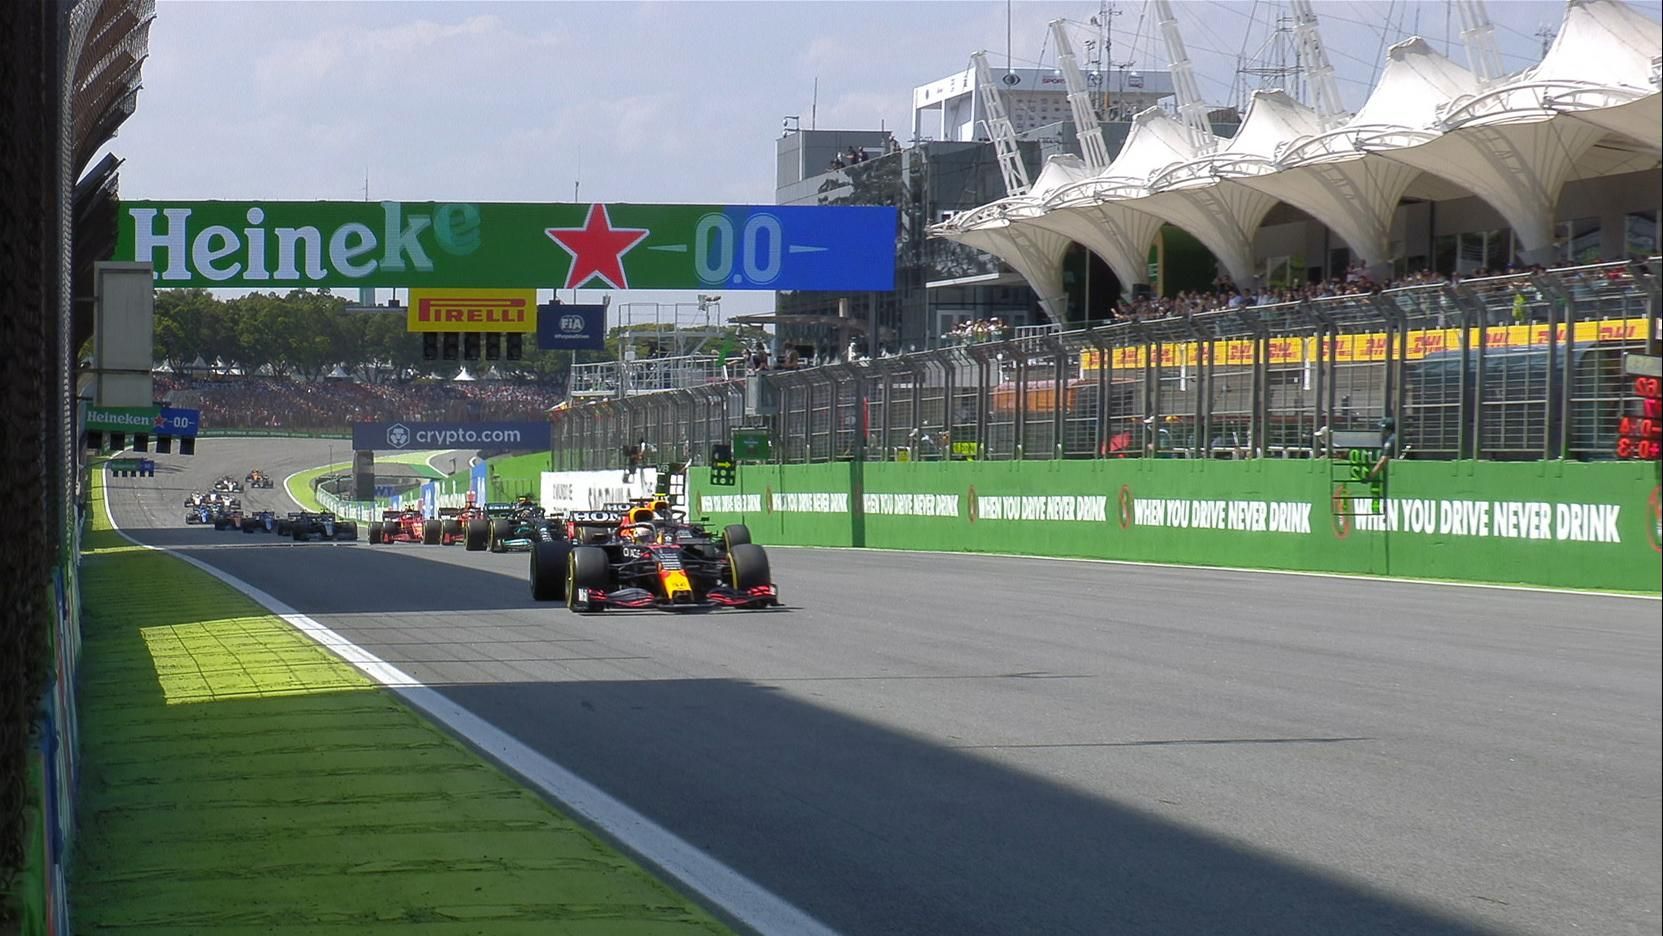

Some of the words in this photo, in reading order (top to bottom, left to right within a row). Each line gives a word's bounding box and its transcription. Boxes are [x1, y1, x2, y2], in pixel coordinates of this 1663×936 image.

[695, 212, 782, 285] 0.0
[418, 297, 526, 322] PIRELLI
[87, 411, 149, 425] Heineken
[416, 426, 521, 448] crypto.com
[978, 496, 1002, 519] WHEN
[1003, 496, 1020, 520] YOU
[1021, 496, 1046, 520] DRIVE
[1047, 496, 1075, 521] NEVER
[1077, 496, 1107, 521] DRINK
[1134, 499, 1165, 526] WHEN
[1167, 500, 1190, 528] YOU
[1192, 500, 1225, 529] DRIVE
[1228, 500, 1267, 532] NEVER
[1269, 502, 1312, 533] DRINK
[1354, 498, 1398, 531] WHEN
[1401, 499, 1436, 534] YOU
[1440, 500, 1489, 536] DRIVE
[1494, 501, 1551, 539] NEVER
[1556, 504, 1621, 543] DRINK
